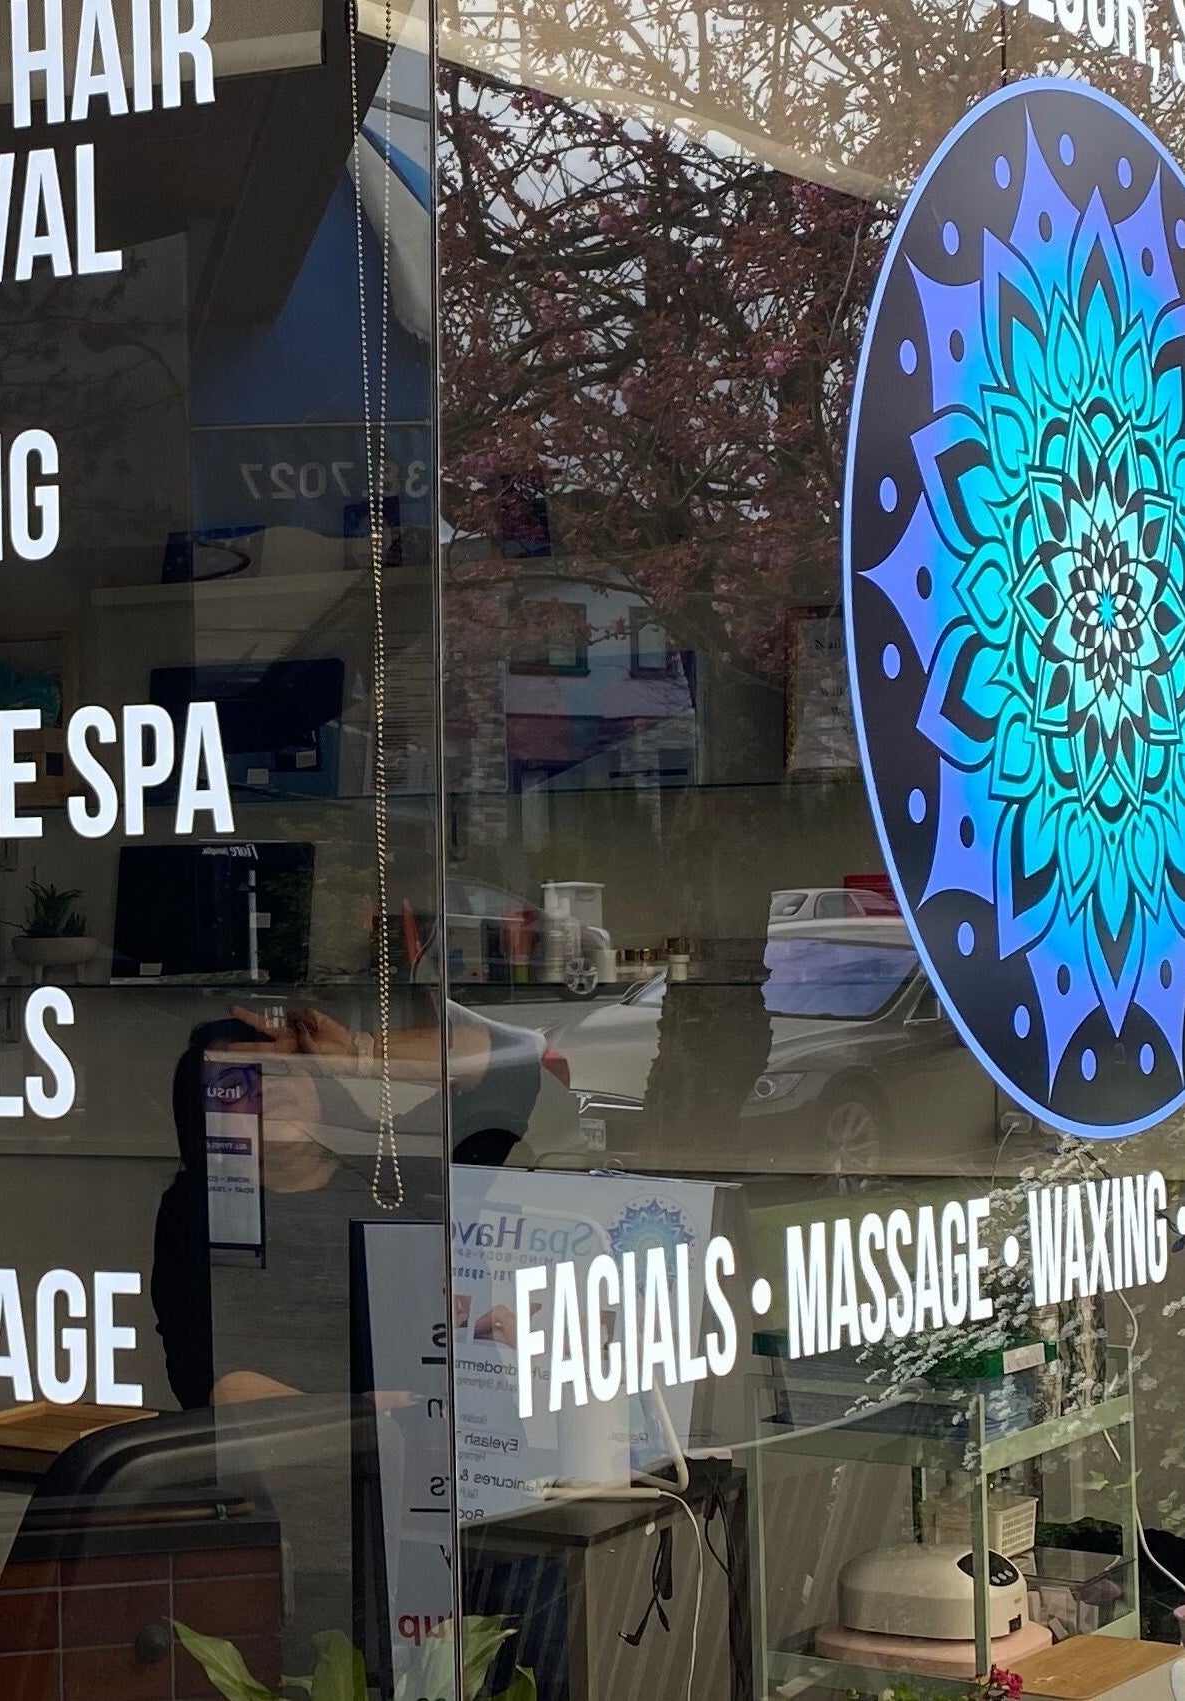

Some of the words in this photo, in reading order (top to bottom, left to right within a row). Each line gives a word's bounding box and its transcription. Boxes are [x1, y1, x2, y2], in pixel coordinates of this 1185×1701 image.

[11, 0, 216, 129] HAIR
[67, 702, 235, 838] SPA
[515, 1236, 738, 1419] FACIALS
[786, 1198, 994, 1359] MASSAGE
[1028, 1171, 1168, 1307] WAXING
